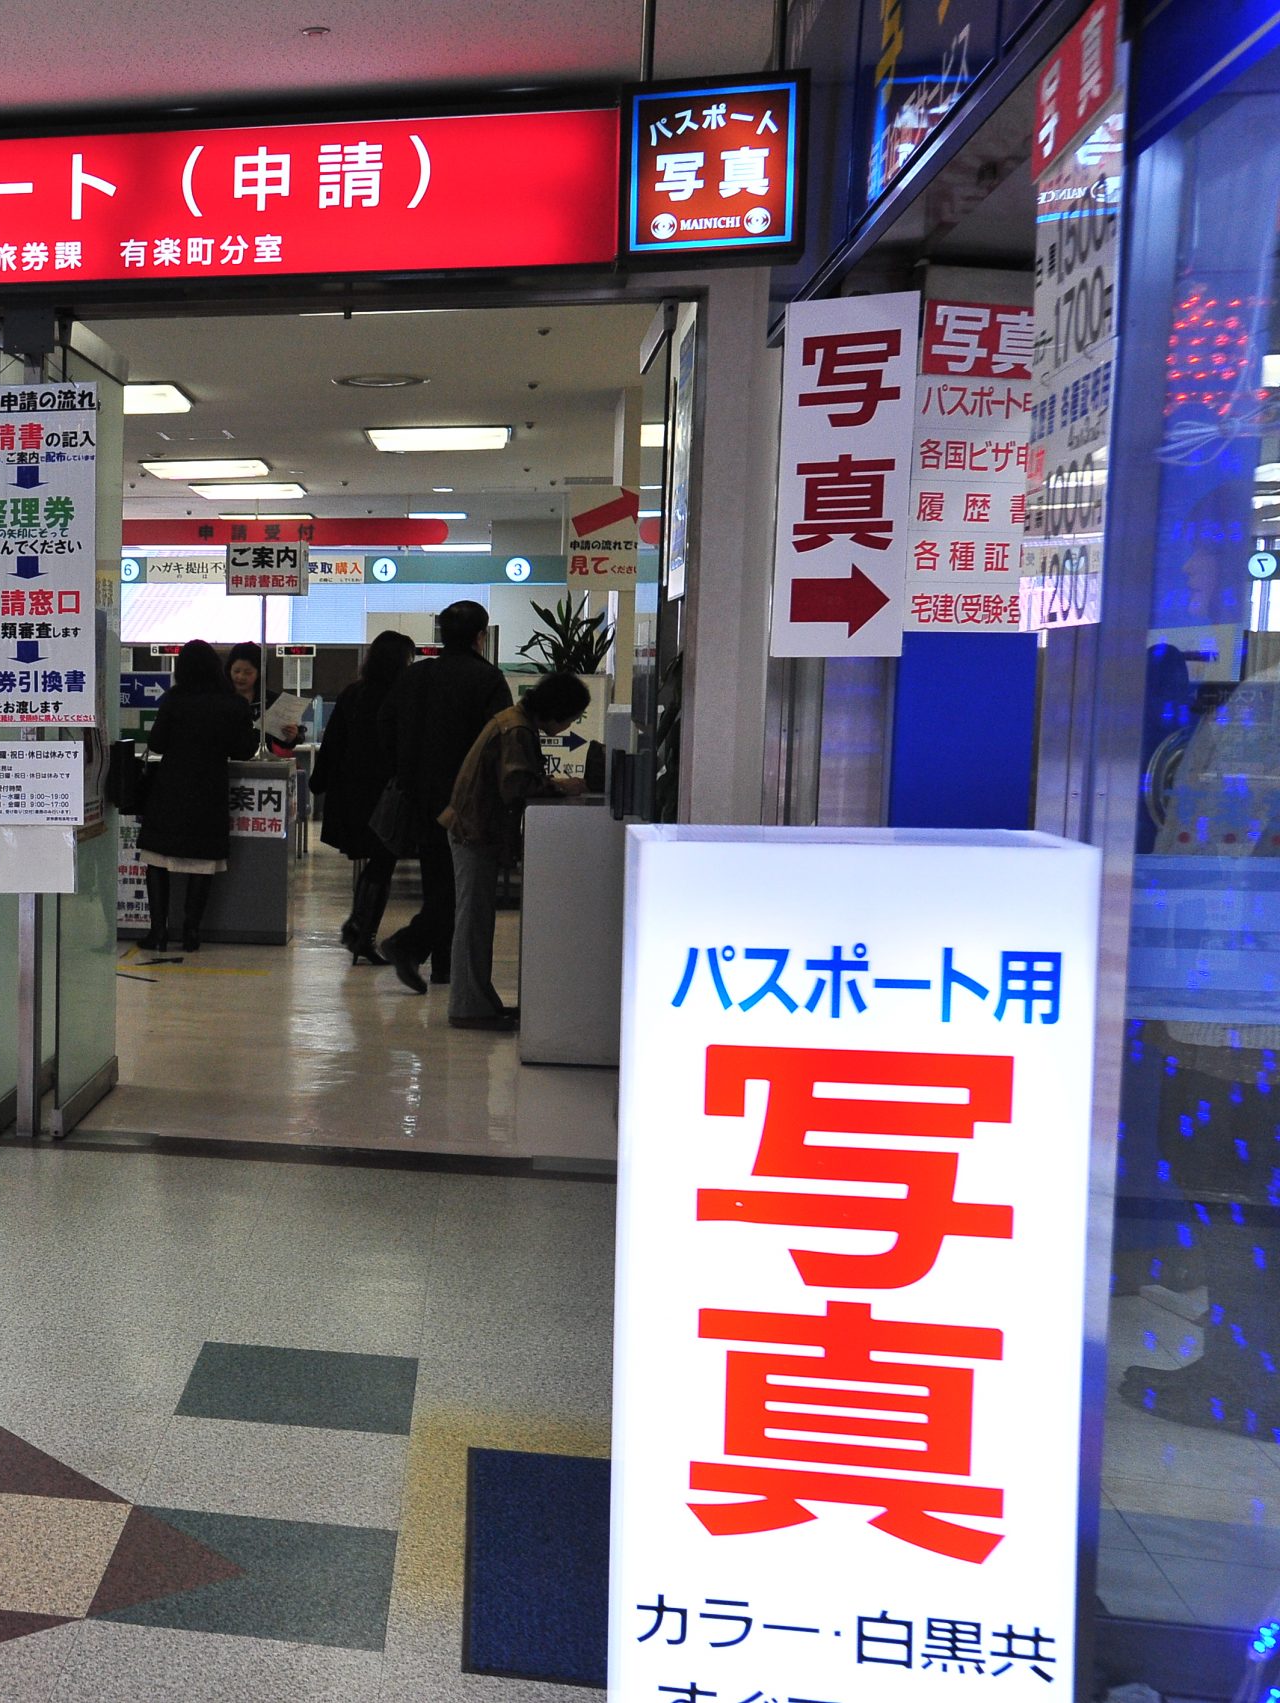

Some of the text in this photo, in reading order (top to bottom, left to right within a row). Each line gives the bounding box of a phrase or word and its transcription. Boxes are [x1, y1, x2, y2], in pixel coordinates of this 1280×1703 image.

[649, 102, 779, 147] パスポート
[654, 145, 770, 202] 写真
[680, 215, 742, 231] MAINICHI
[120, 233, 285, 268] 有楽町分室
[930, 304, 1034, 376] 写真
[791, 329, 903, 553] 写真
[198, 523, 315, 541] 申請受付
[123, 563, 132, 576] 6
[230, 546, 298, 569] ご案内
[379, 563, 388, 576] 4
[513, 563, 523, 577] 3
[913, 539, 1023, 573] 各種証
[231, 574, 299, 588] 申請書配布
[229, 785, 282, 813] 案内
[670, 942, 1064, 1025] パスポート用
[684, 1043, 1015, 1566] 写真
